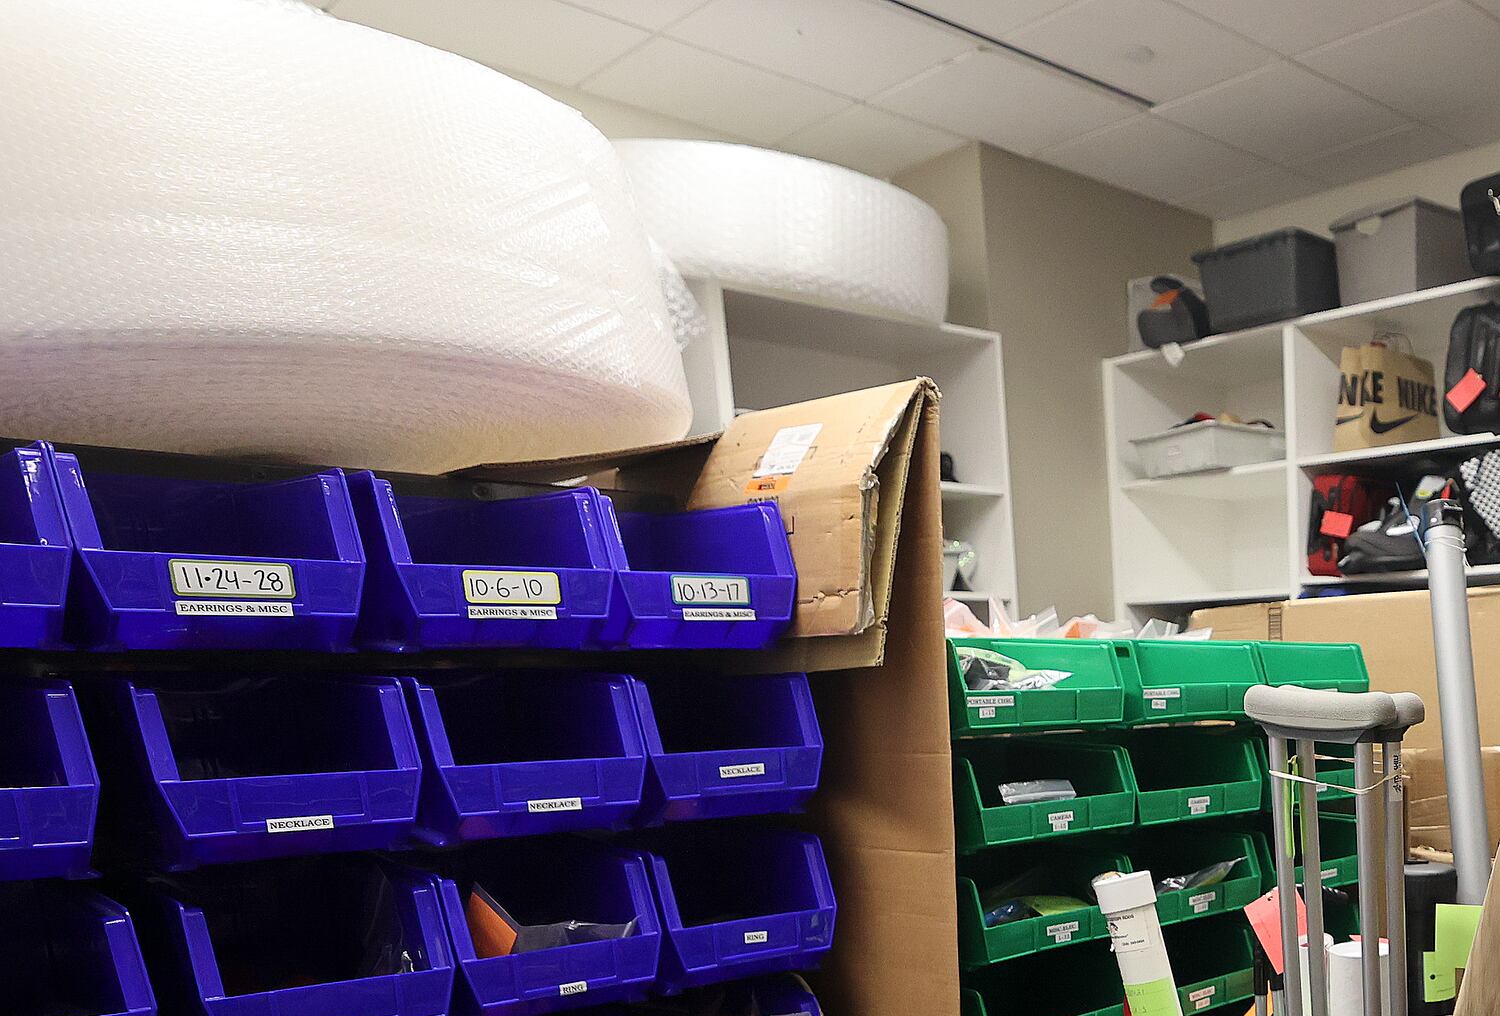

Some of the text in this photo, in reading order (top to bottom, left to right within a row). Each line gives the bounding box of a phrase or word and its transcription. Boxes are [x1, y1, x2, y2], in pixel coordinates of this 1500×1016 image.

[180, 603, 288, 613] EARRINGS & MISC
[469, 608, 518, 617] EARRINGS
[529, 609, 553, 617] MISC
[684, 610, 724, 618] EARRINGS
[721, 765, 761, 778] NECKLACE
[529, 799, 577, 811] NECKLACE
[1050, 812, 1073, 823] CAMERA
[269, 816, 330, 831] NECKLACE
[746, 932, 765, 942] RING
[562, 982, 585, 994] RING
